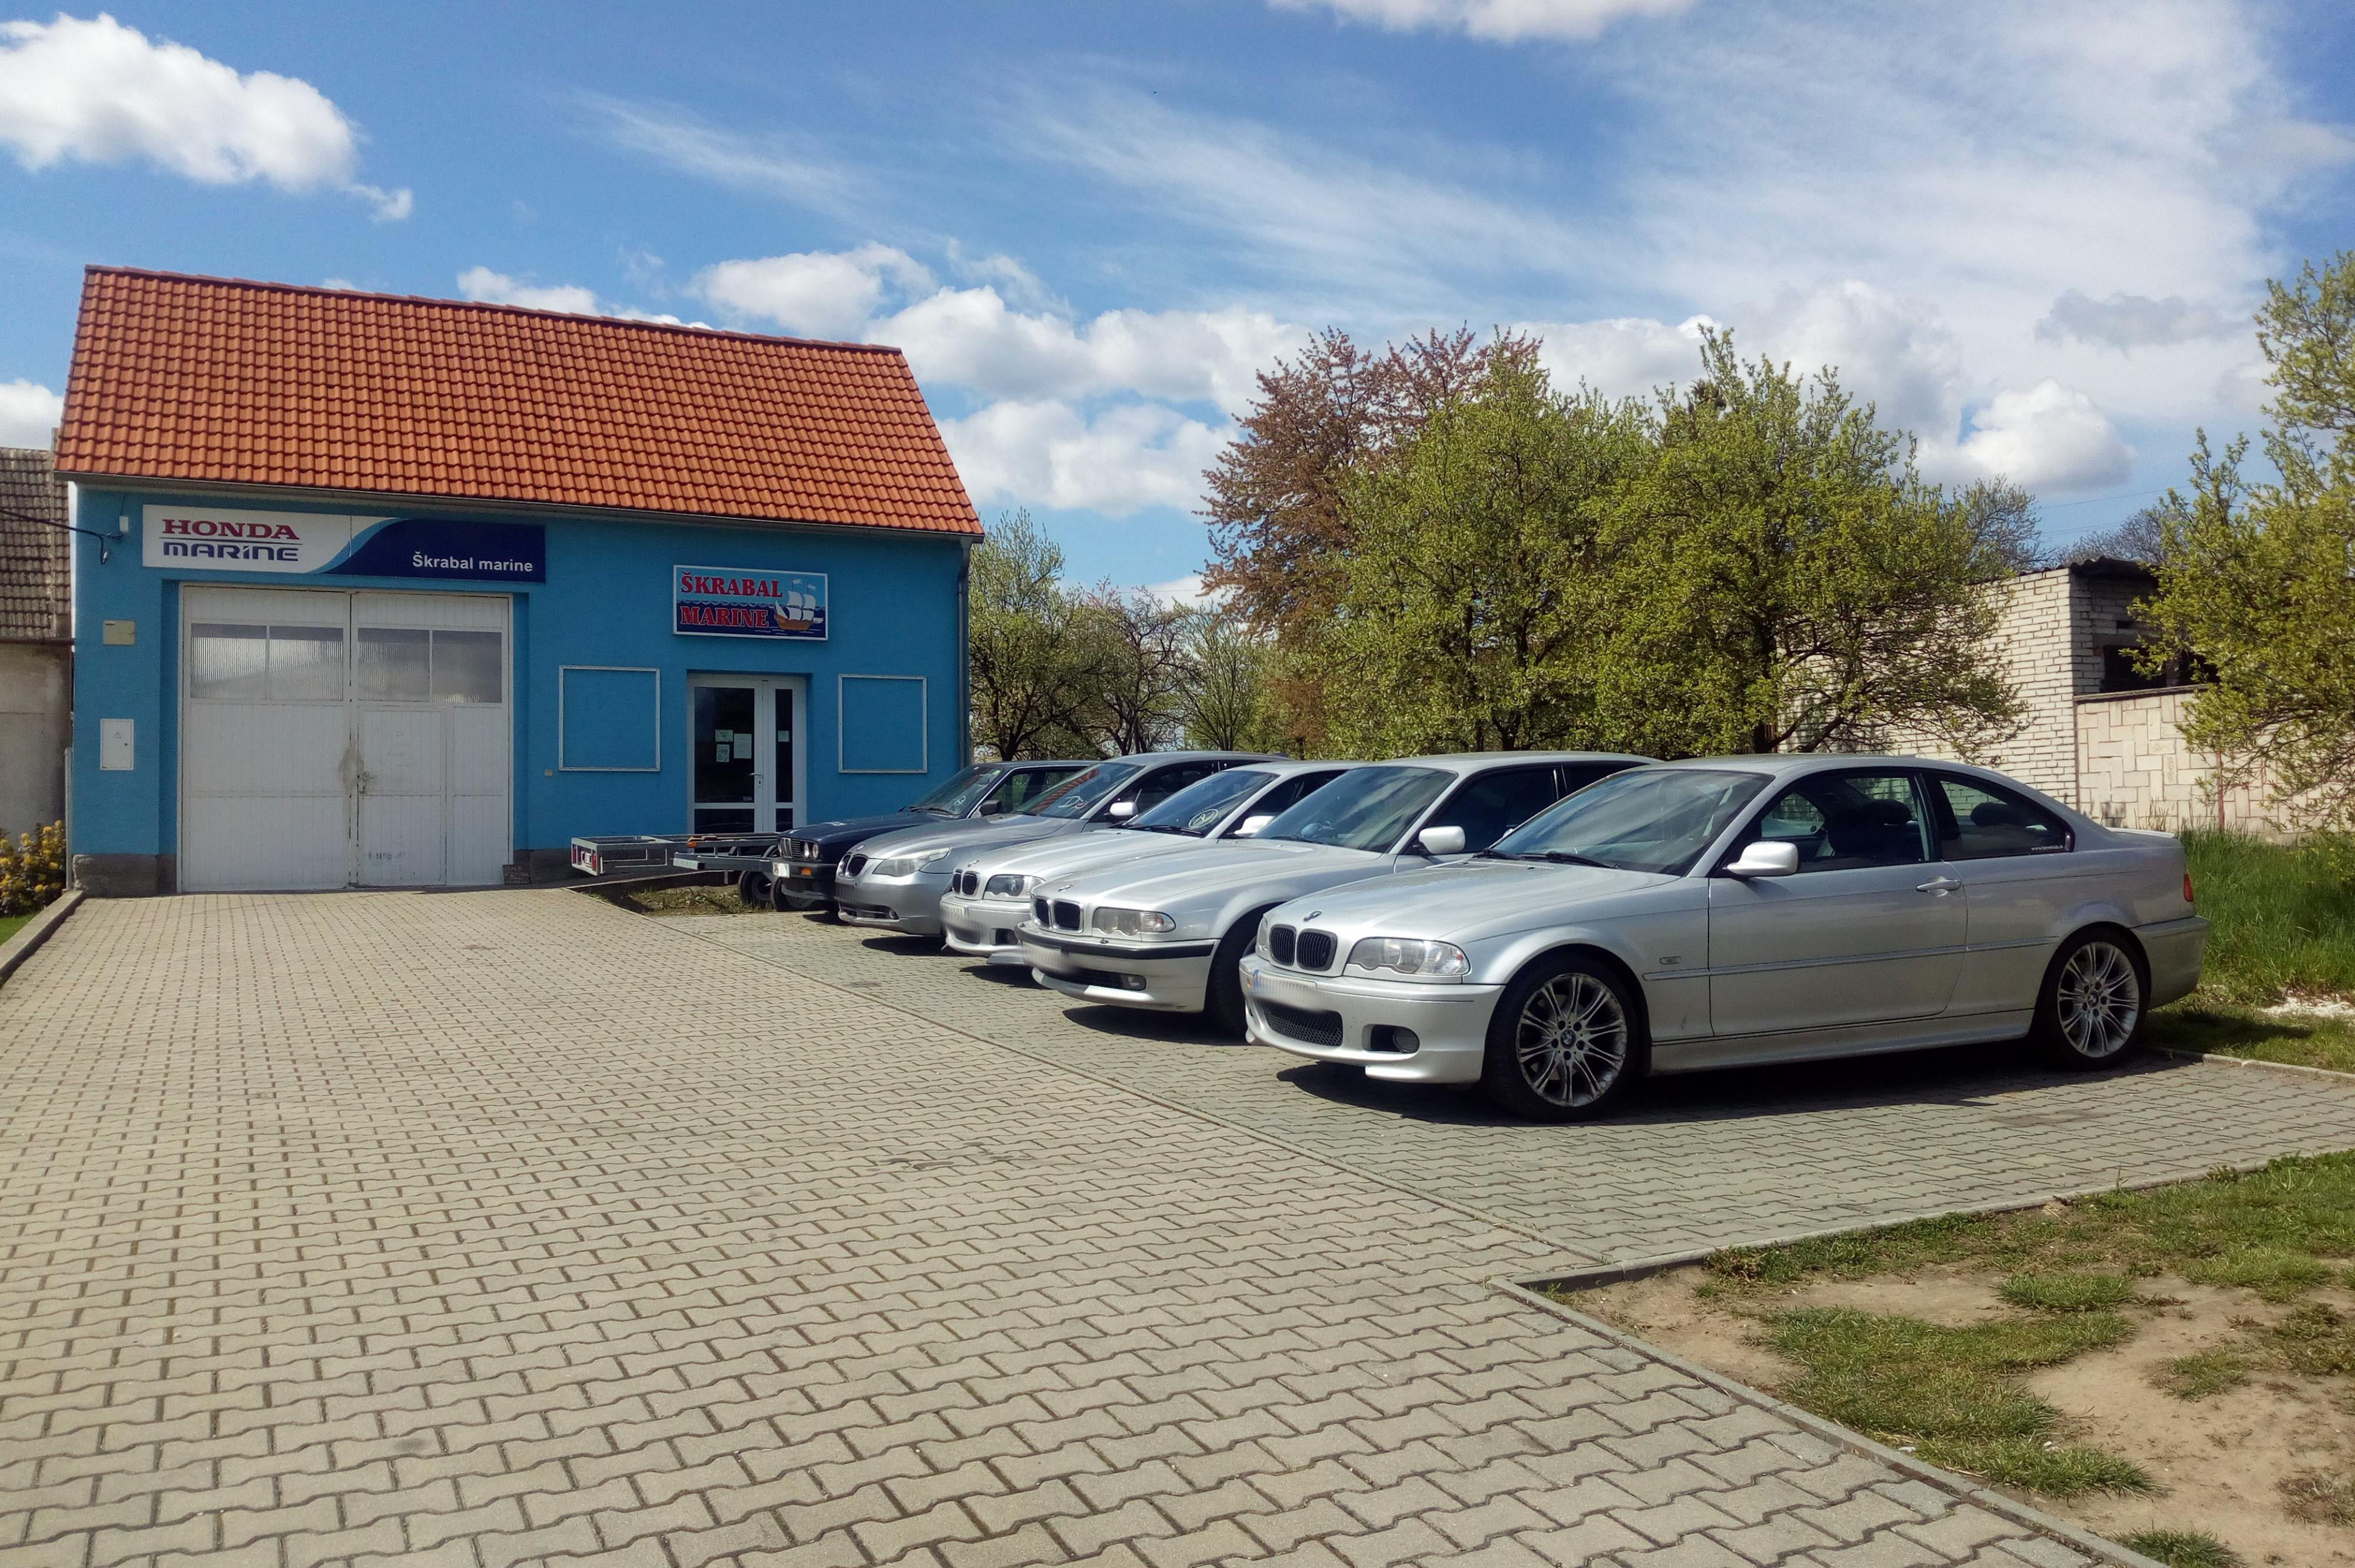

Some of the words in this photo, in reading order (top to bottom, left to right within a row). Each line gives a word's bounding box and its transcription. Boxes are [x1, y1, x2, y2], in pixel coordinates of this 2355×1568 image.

[162, 518, 300, 540] HONDA
[413, 551, 473, 569] Škrabal
[479, 559, 533, 572] marine
[681, 572, 782, 597] ŠKRABAL
[681, 606, 769, 627] MARINE
